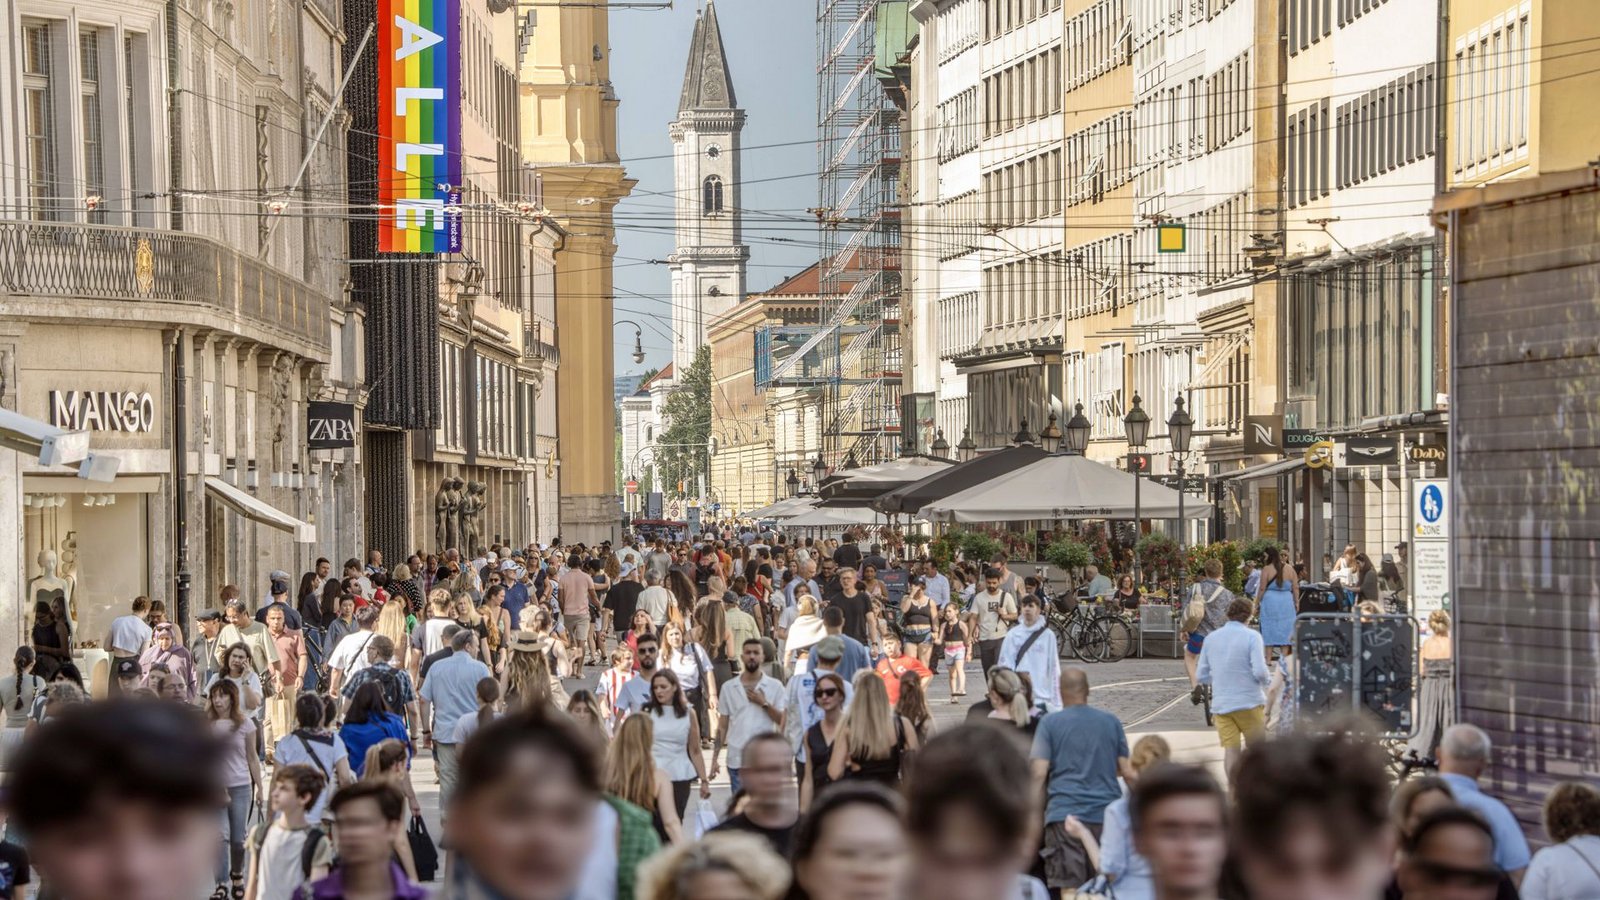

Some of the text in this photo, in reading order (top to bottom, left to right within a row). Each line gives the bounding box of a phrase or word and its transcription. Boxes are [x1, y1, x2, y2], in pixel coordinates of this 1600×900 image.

[395, 14, 444, 230] ALLE
[51, 390, 153, 432] MANGO
[309, 418, 355, 440] ZARA
[1287, 434, 1326, 443] DOUGLAS
[1413, 447, 1446, 461] DoDo
[1063, 508, 1097, 516] Augustiner
[1423, 525, 1440, 535] ZONE
